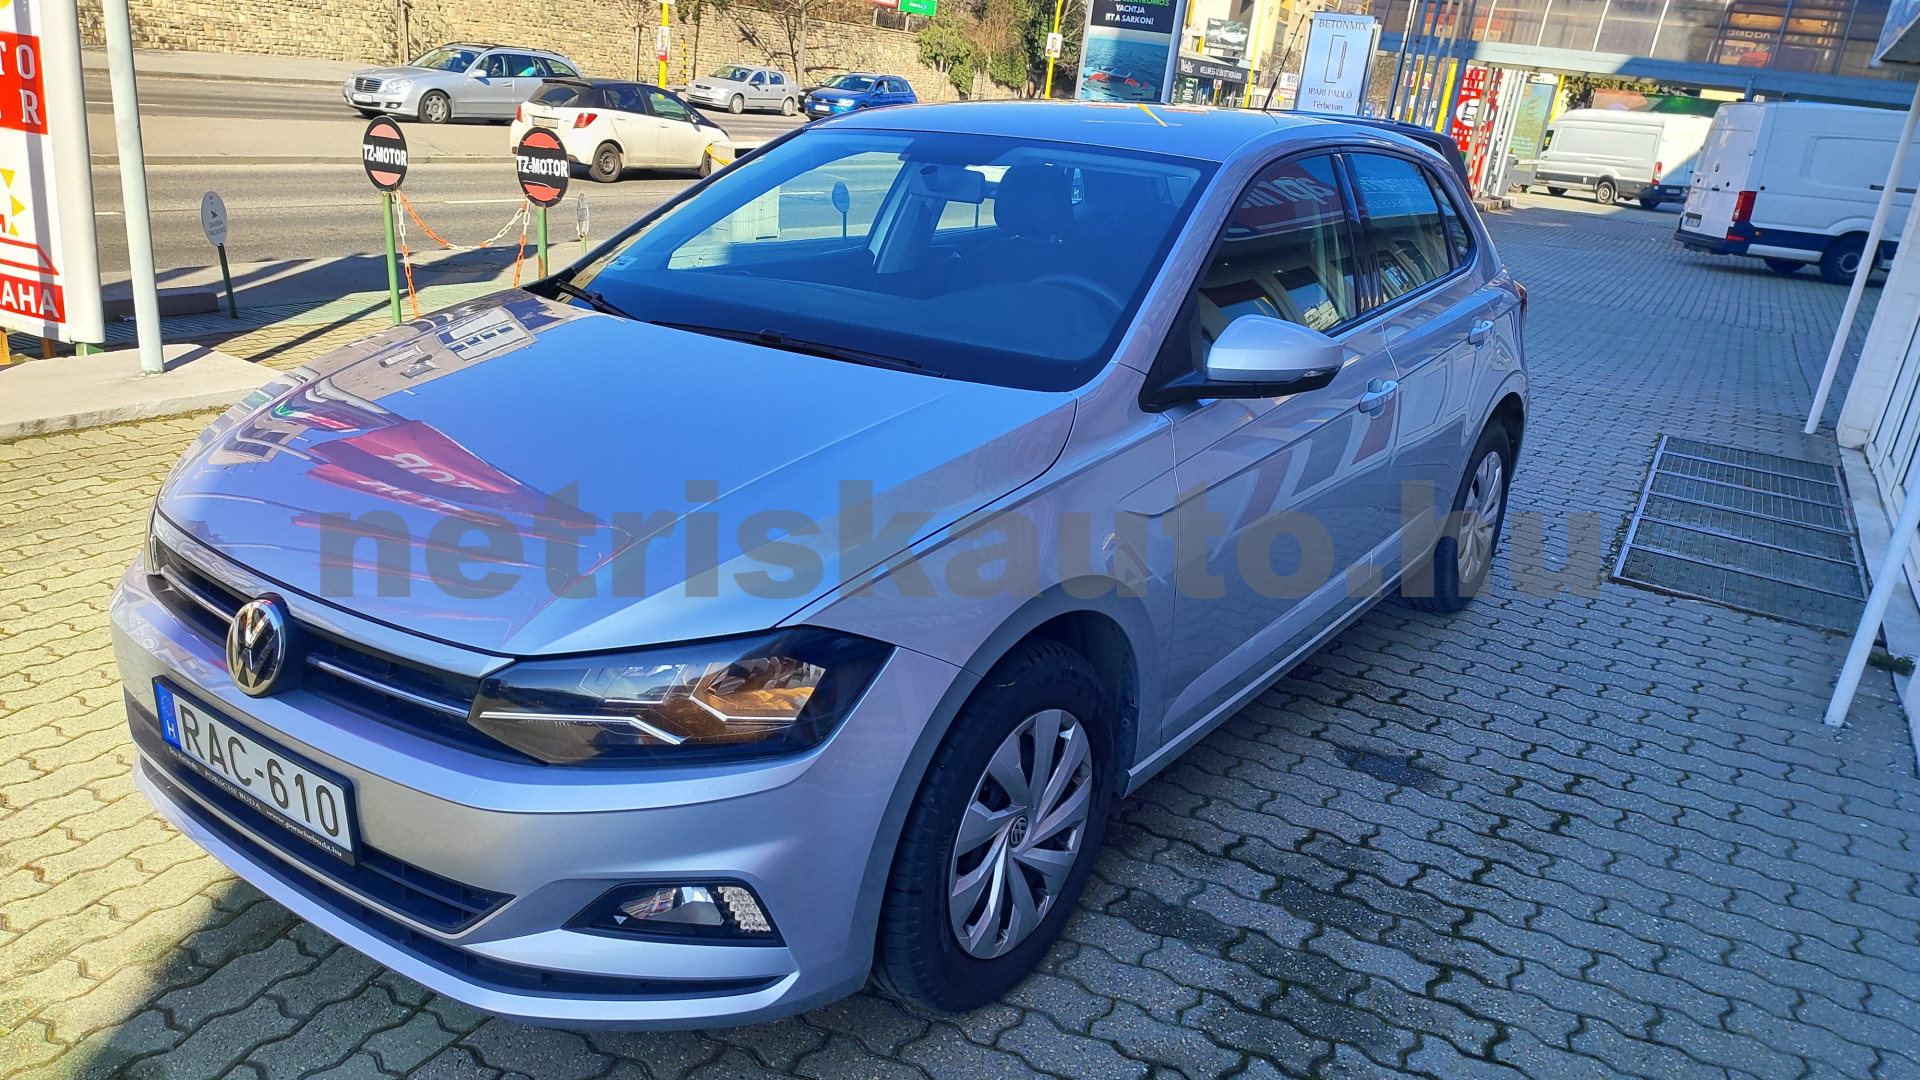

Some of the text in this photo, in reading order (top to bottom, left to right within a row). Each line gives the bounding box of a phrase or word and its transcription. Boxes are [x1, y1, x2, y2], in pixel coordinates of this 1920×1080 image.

[1115, 4, 1145, 14] YACHTJA
[1121, 15, 1154, 25] SARKON!
[1319, 20, 1368, 31] BETONMIX
[1328, 89, 1352, 99] PADLÓ
[1313, 101, 1343, 111] Térbeton
[363, 144, 407, 166] TZ-MOTOR
[517, 156, 568, 177] TZ-MOTOR
[0, 280, 60, 318] AHA
[179, 703, 339, 838] RAC-610
[204, 770, 238, 797] PORSCHE
